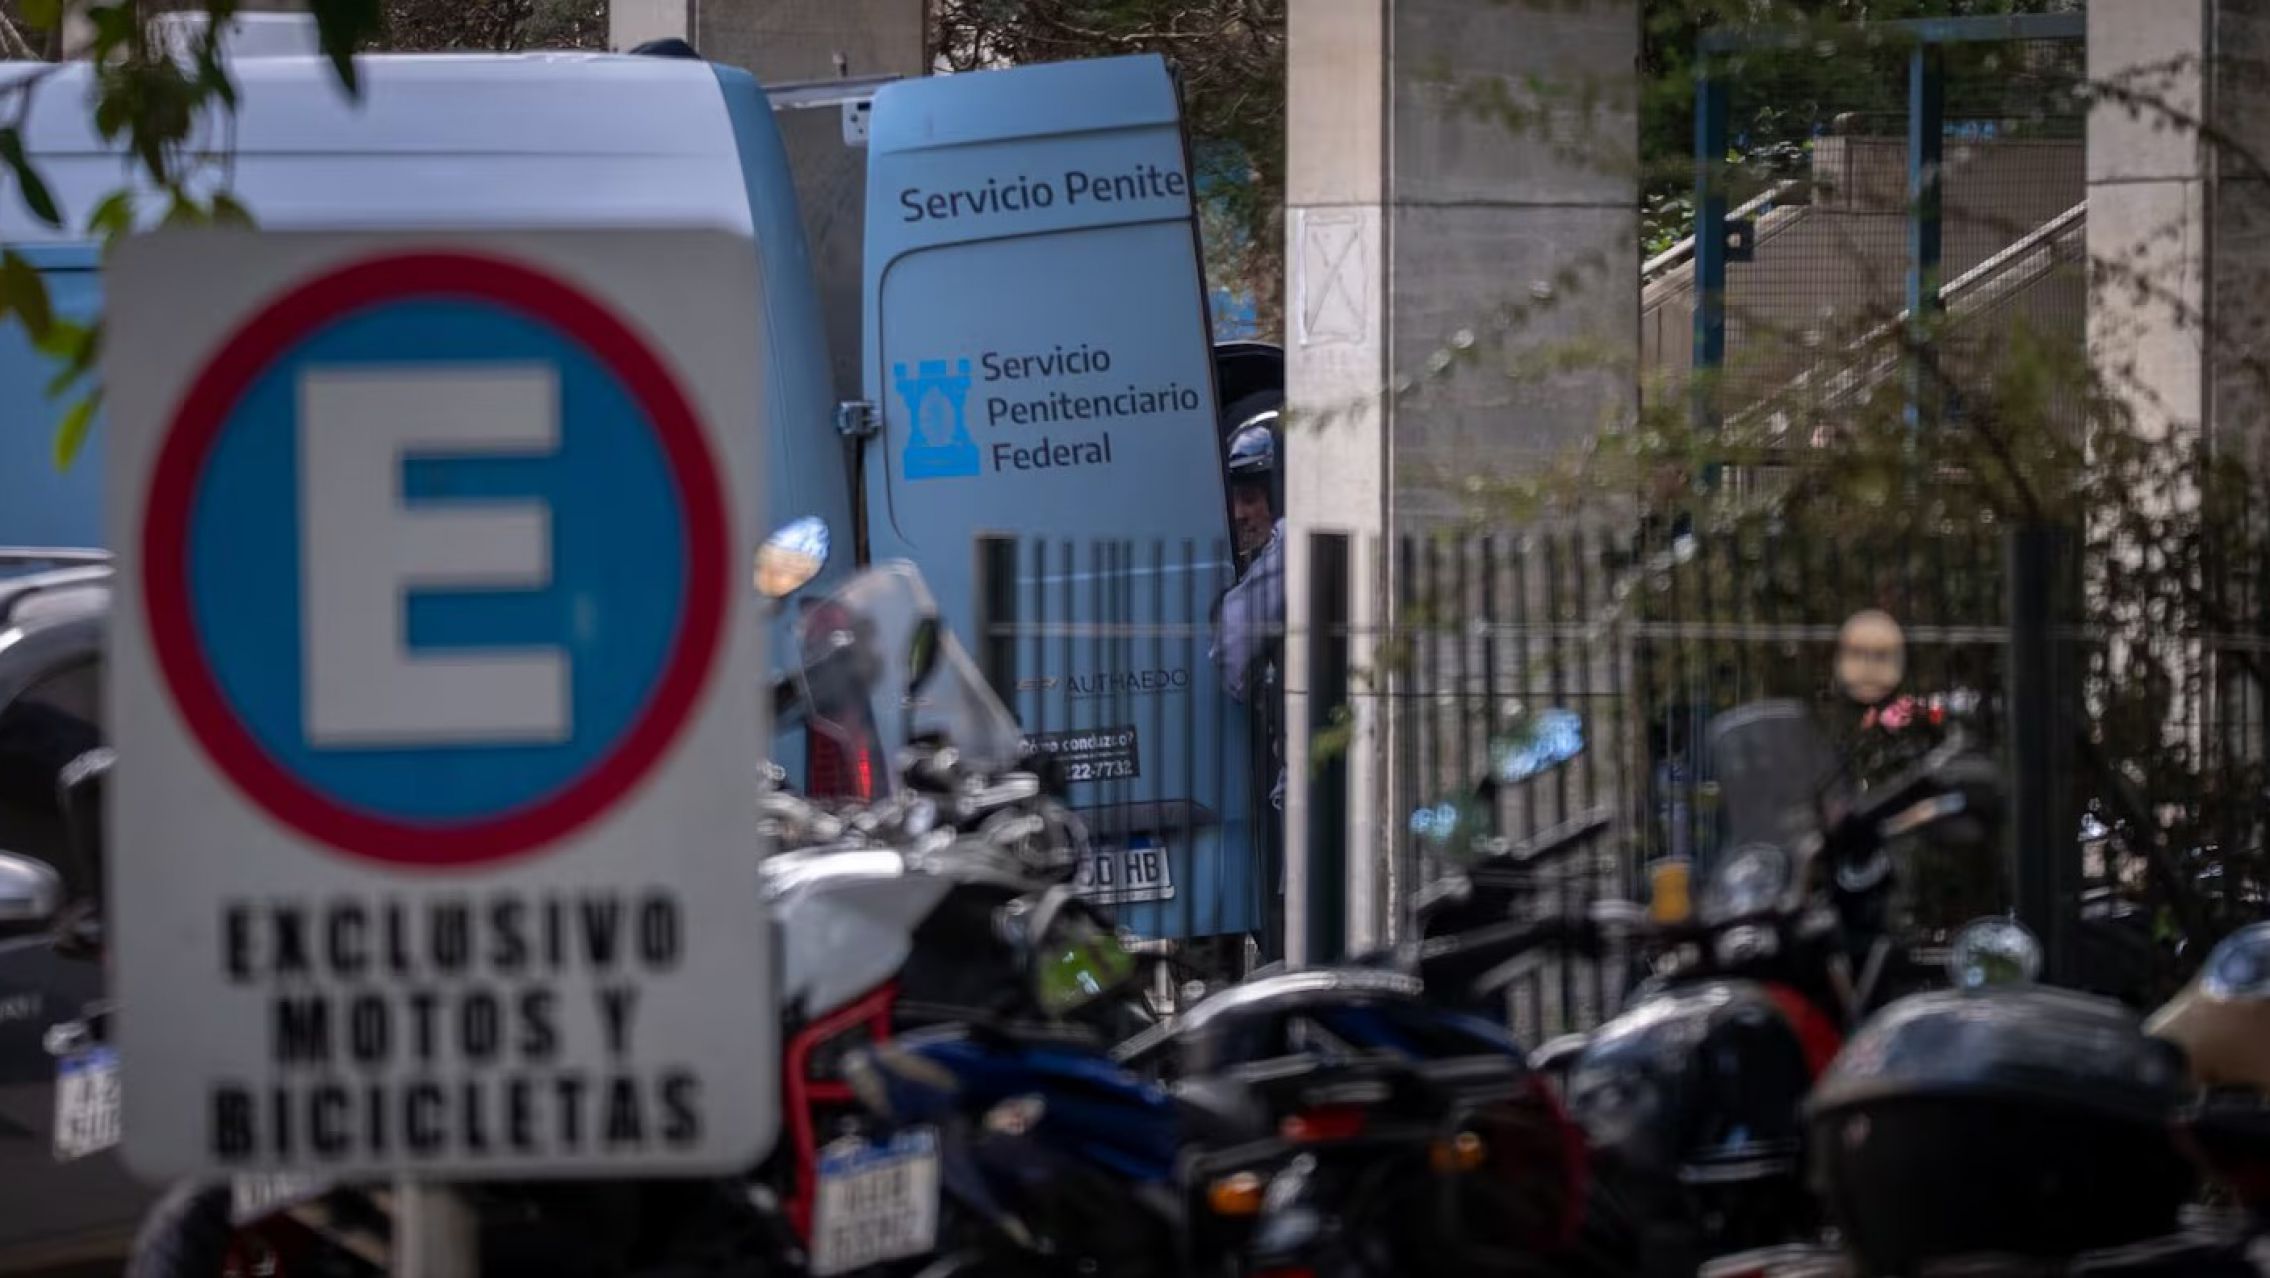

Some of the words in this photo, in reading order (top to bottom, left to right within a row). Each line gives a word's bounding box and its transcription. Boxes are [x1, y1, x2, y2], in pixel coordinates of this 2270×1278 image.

[901, 177, 1054, 222] Servicio
[1064, 165, 1185, 205] Penite
[981, 343, 1111, 382] Servicio
[987, 382, 1200, 426] Penitenciario
[992, 432, 1112, 472] Federal
[304, 365, 572, 750] E
[1064, 760, 1133, 779] 22-7732
[1125, 852, 1160, 884] HB
[224, 893, 682, 981] EXCLUSIVO
[275, 990, 558, 1063] MOTOS
[597, 986, 640, 1054] Y
[212, 1074, 702, 1163] BICICLETAS
